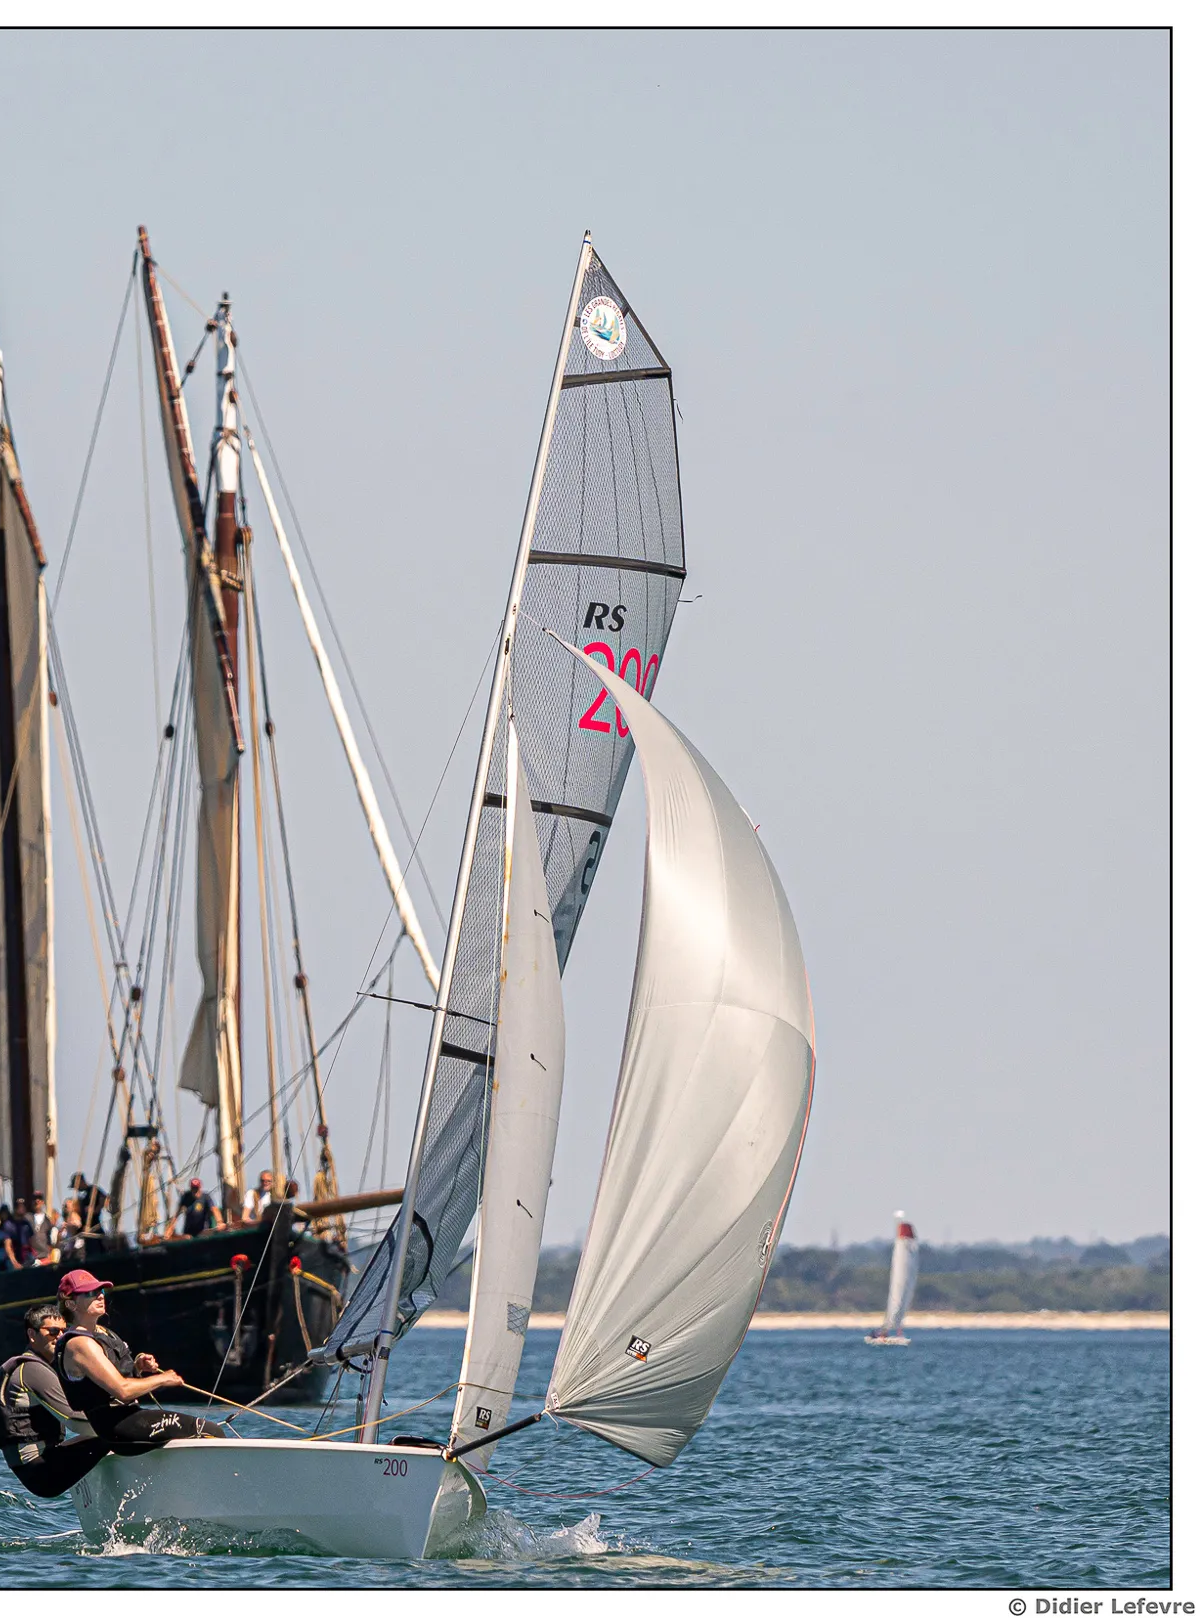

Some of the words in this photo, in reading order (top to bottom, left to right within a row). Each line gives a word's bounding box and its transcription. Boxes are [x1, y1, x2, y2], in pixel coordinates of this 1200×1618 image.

[583, 602, 627, 632] RS
[631, 1338, 650, 1353] RS
[479, 1409, 491, 1421] RS
[383, 1458, 408, 1477] 200
